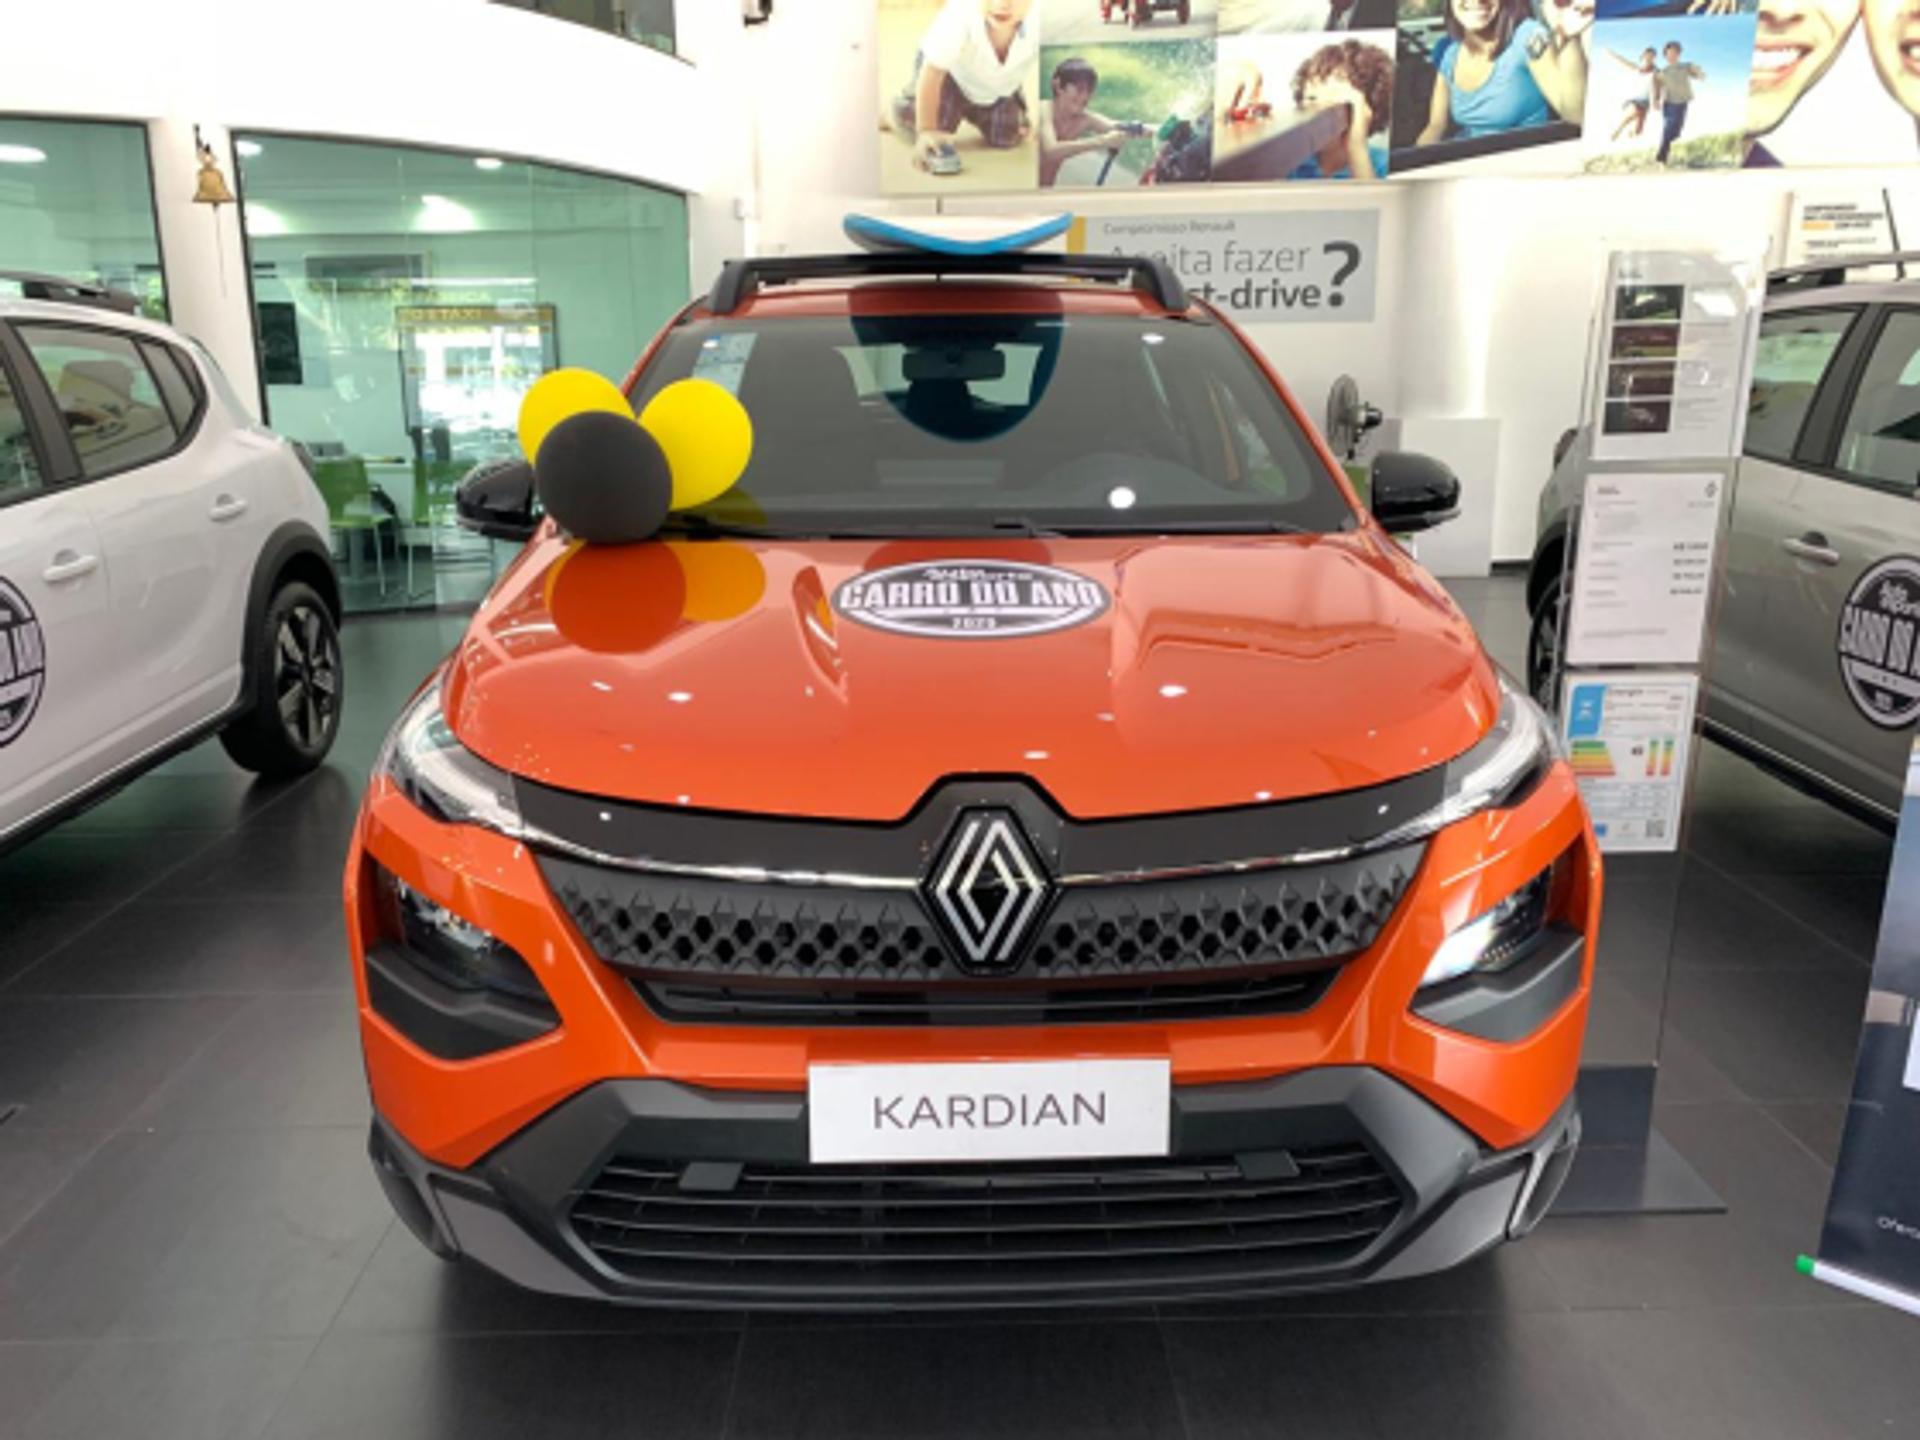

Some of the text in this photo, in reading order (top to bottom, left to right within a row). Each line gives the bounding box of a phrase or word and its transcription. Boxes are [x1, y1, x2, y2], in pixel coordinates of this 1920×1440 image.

[1223, 240, 1311, 273] fazer
[839, 580, 1103, 609] CARRO DO ANO
[873, 1091, 1106, 1130] KARDIAN
